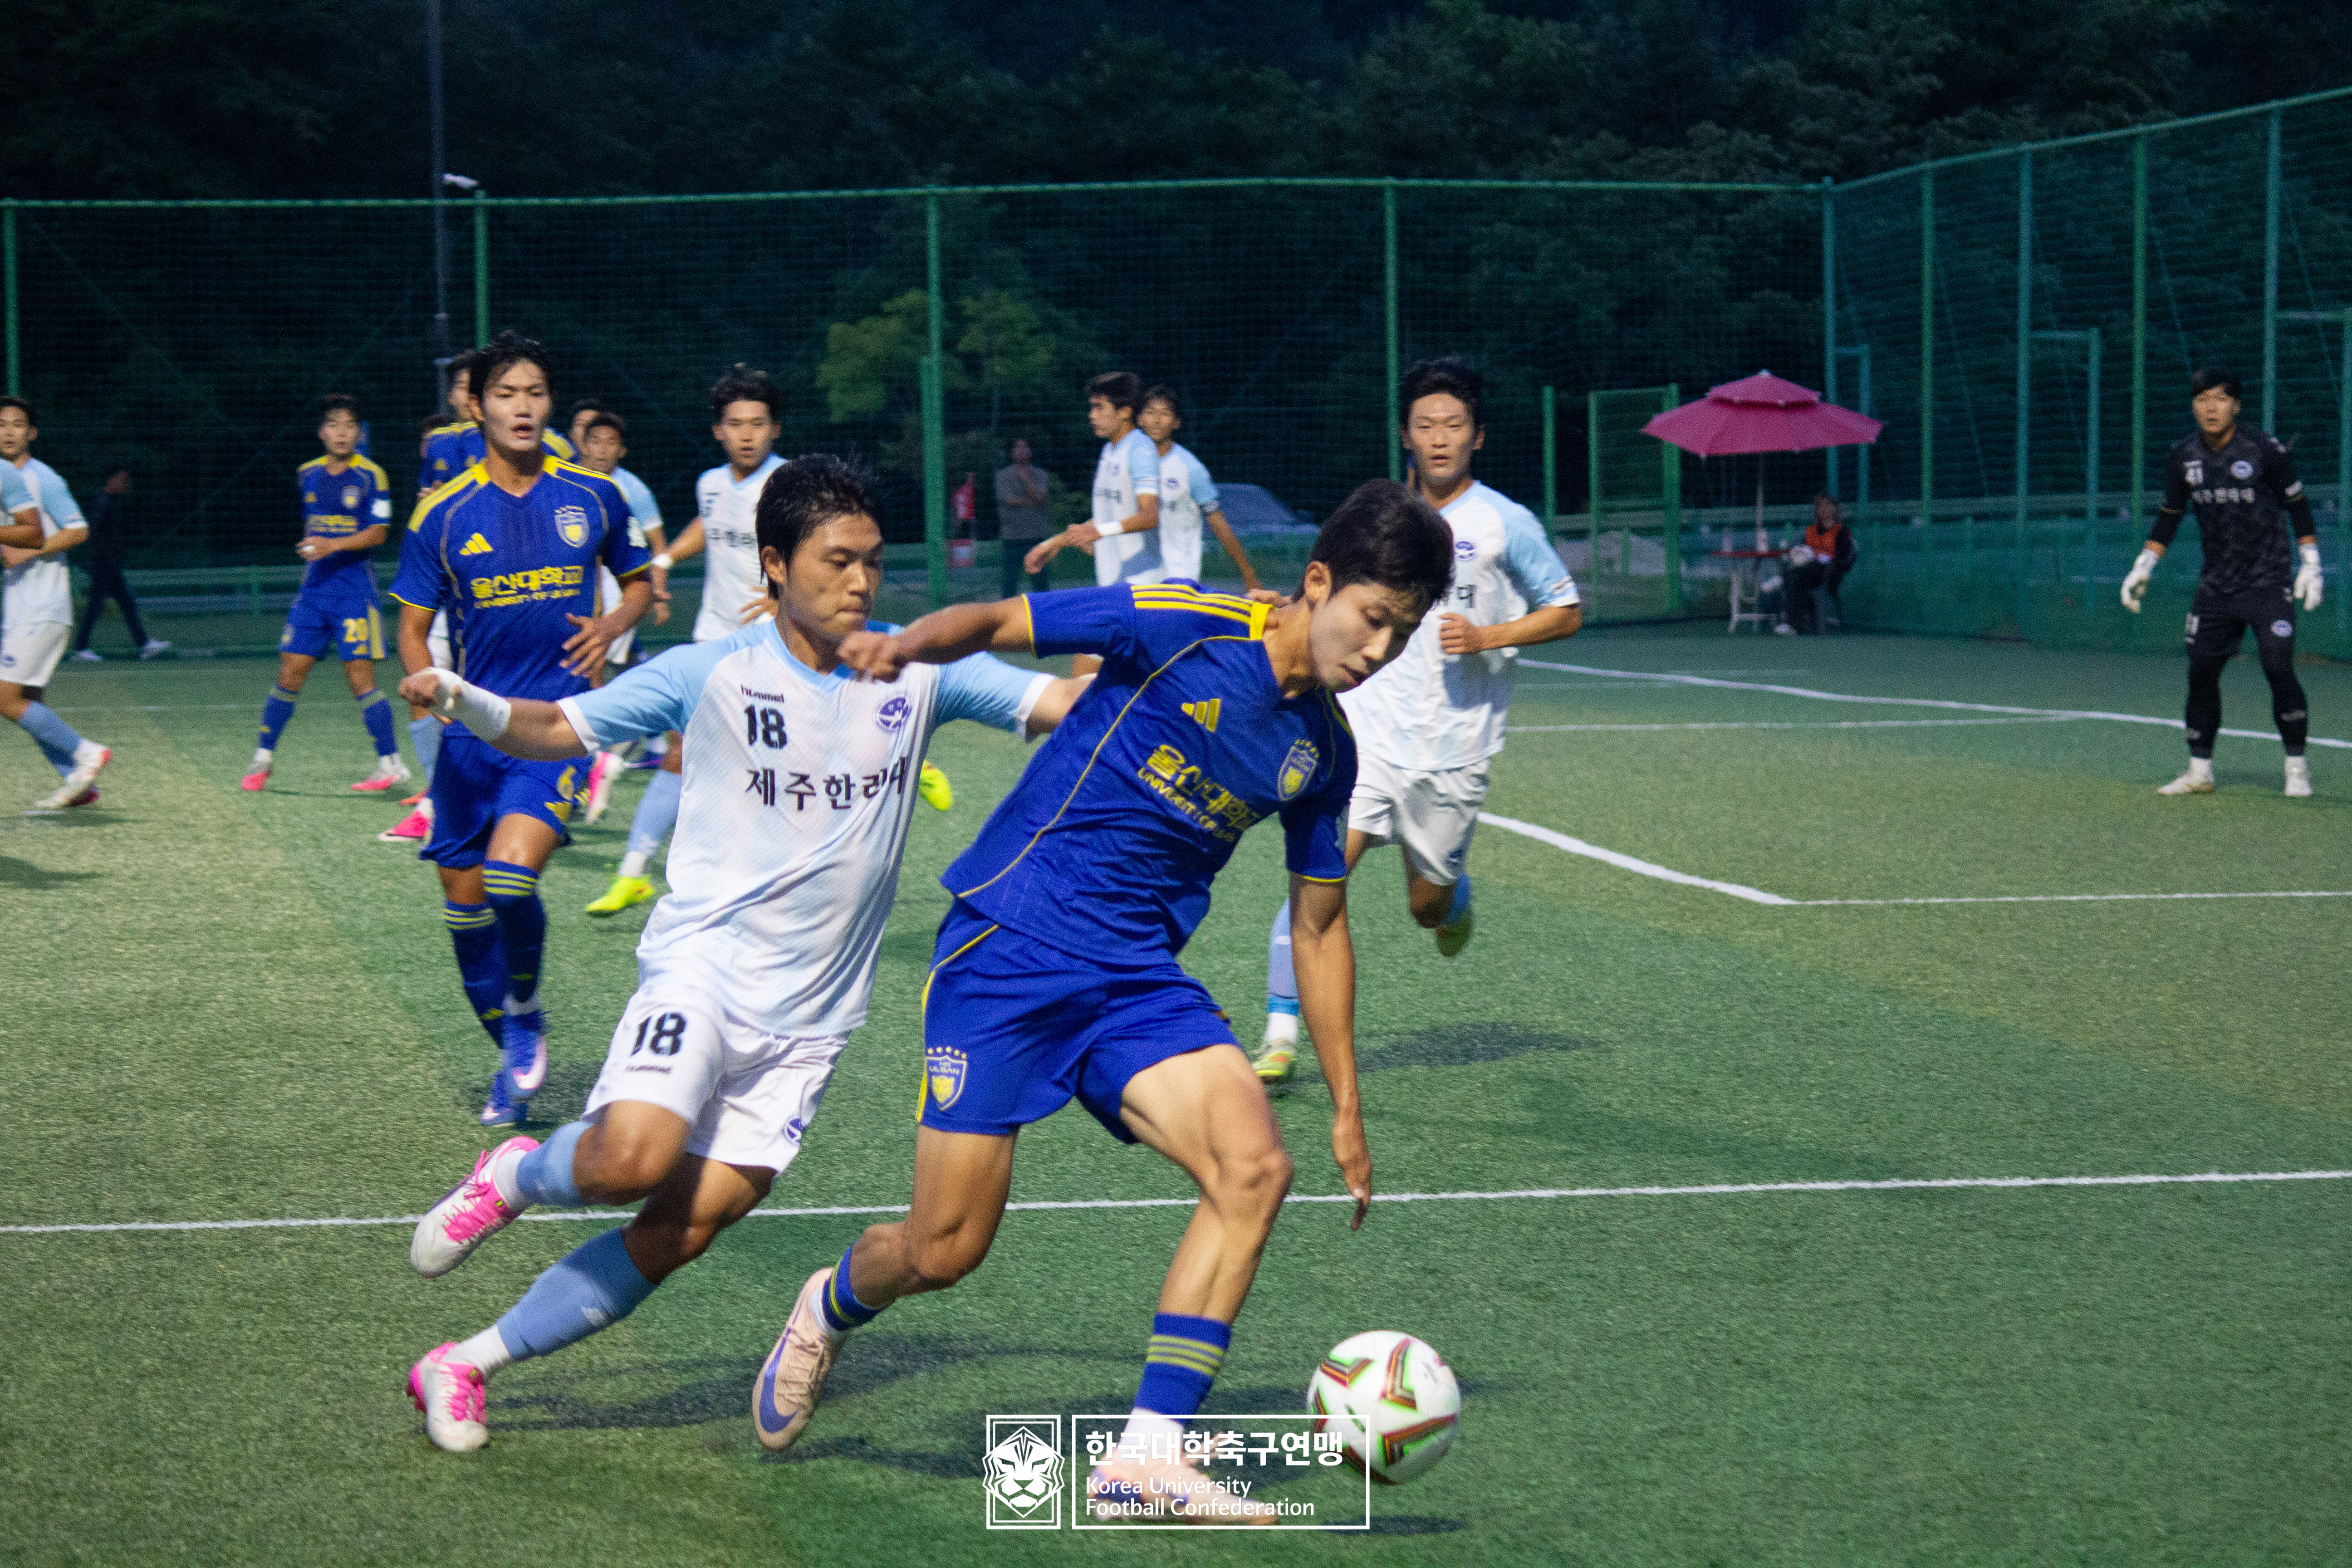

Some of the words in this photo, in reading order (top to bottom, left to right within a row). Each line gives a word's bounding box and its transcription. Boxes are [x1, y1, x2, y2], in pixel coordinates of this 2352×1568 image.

[740, 685, 784, 703] hummel
[744, 705, 787, 749] 18
[629, 1011, 687, 1057] 18
